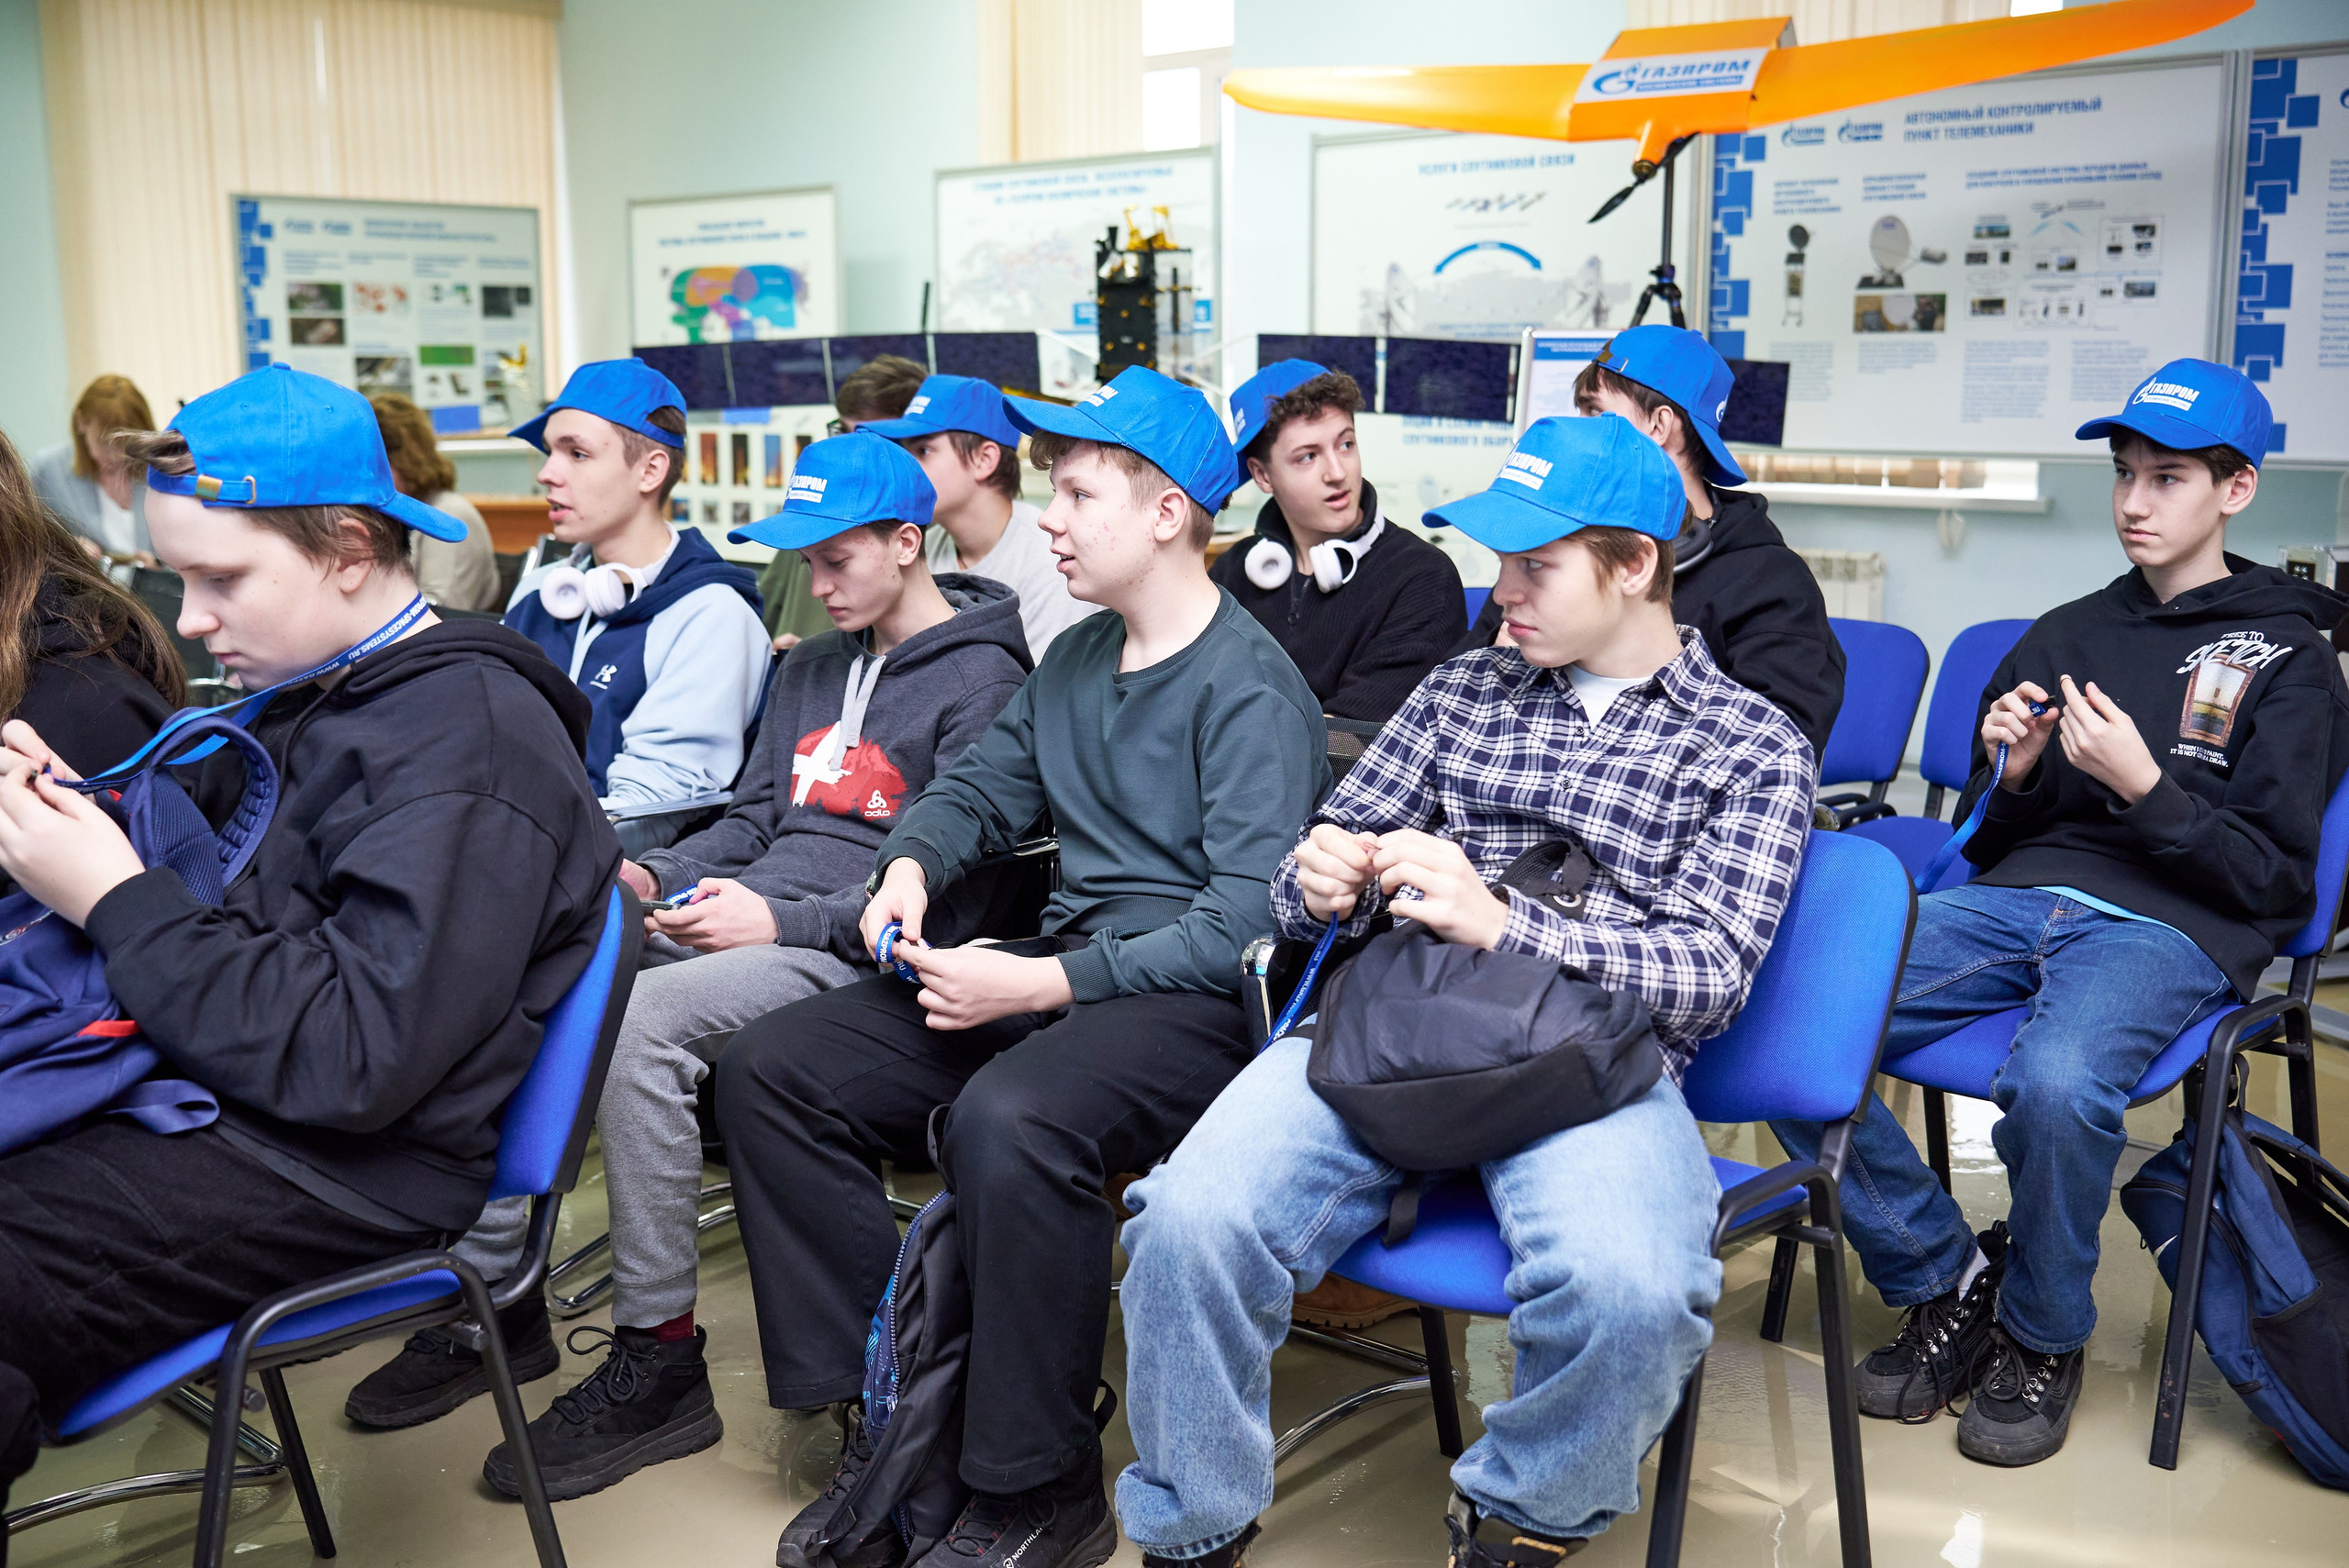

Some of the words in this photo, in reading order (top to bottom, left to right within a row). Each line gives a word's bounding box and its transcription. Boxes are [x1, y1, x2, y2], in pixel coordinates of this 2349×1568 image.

[1642, 60, 1752, 79] ГАЗПРОМ
[1905, 106, 1984, 126] АВТОНОМНЫЙ
[1987, 97, 2102, 120] КОНТРОЛИРУЕМЫЙ
[1904, 128, 1940, 142] ПУНКТ
[1944, 122, 2034, 140] ТЕЛЕМЕХАНИКИ
[2149, 383, 2200, 402] ГАЗПРОМ
[2221, 631, 2248, 639] FREE
[2248, 630, 2265, 642] TO
[2176, 639, 2293, 674] SKETCH
[2177, 743, 2197, 751] WHEN
[864, 808, 890, 817] odlo
[1011, 1527, 1043, 1561] NORTHLA
